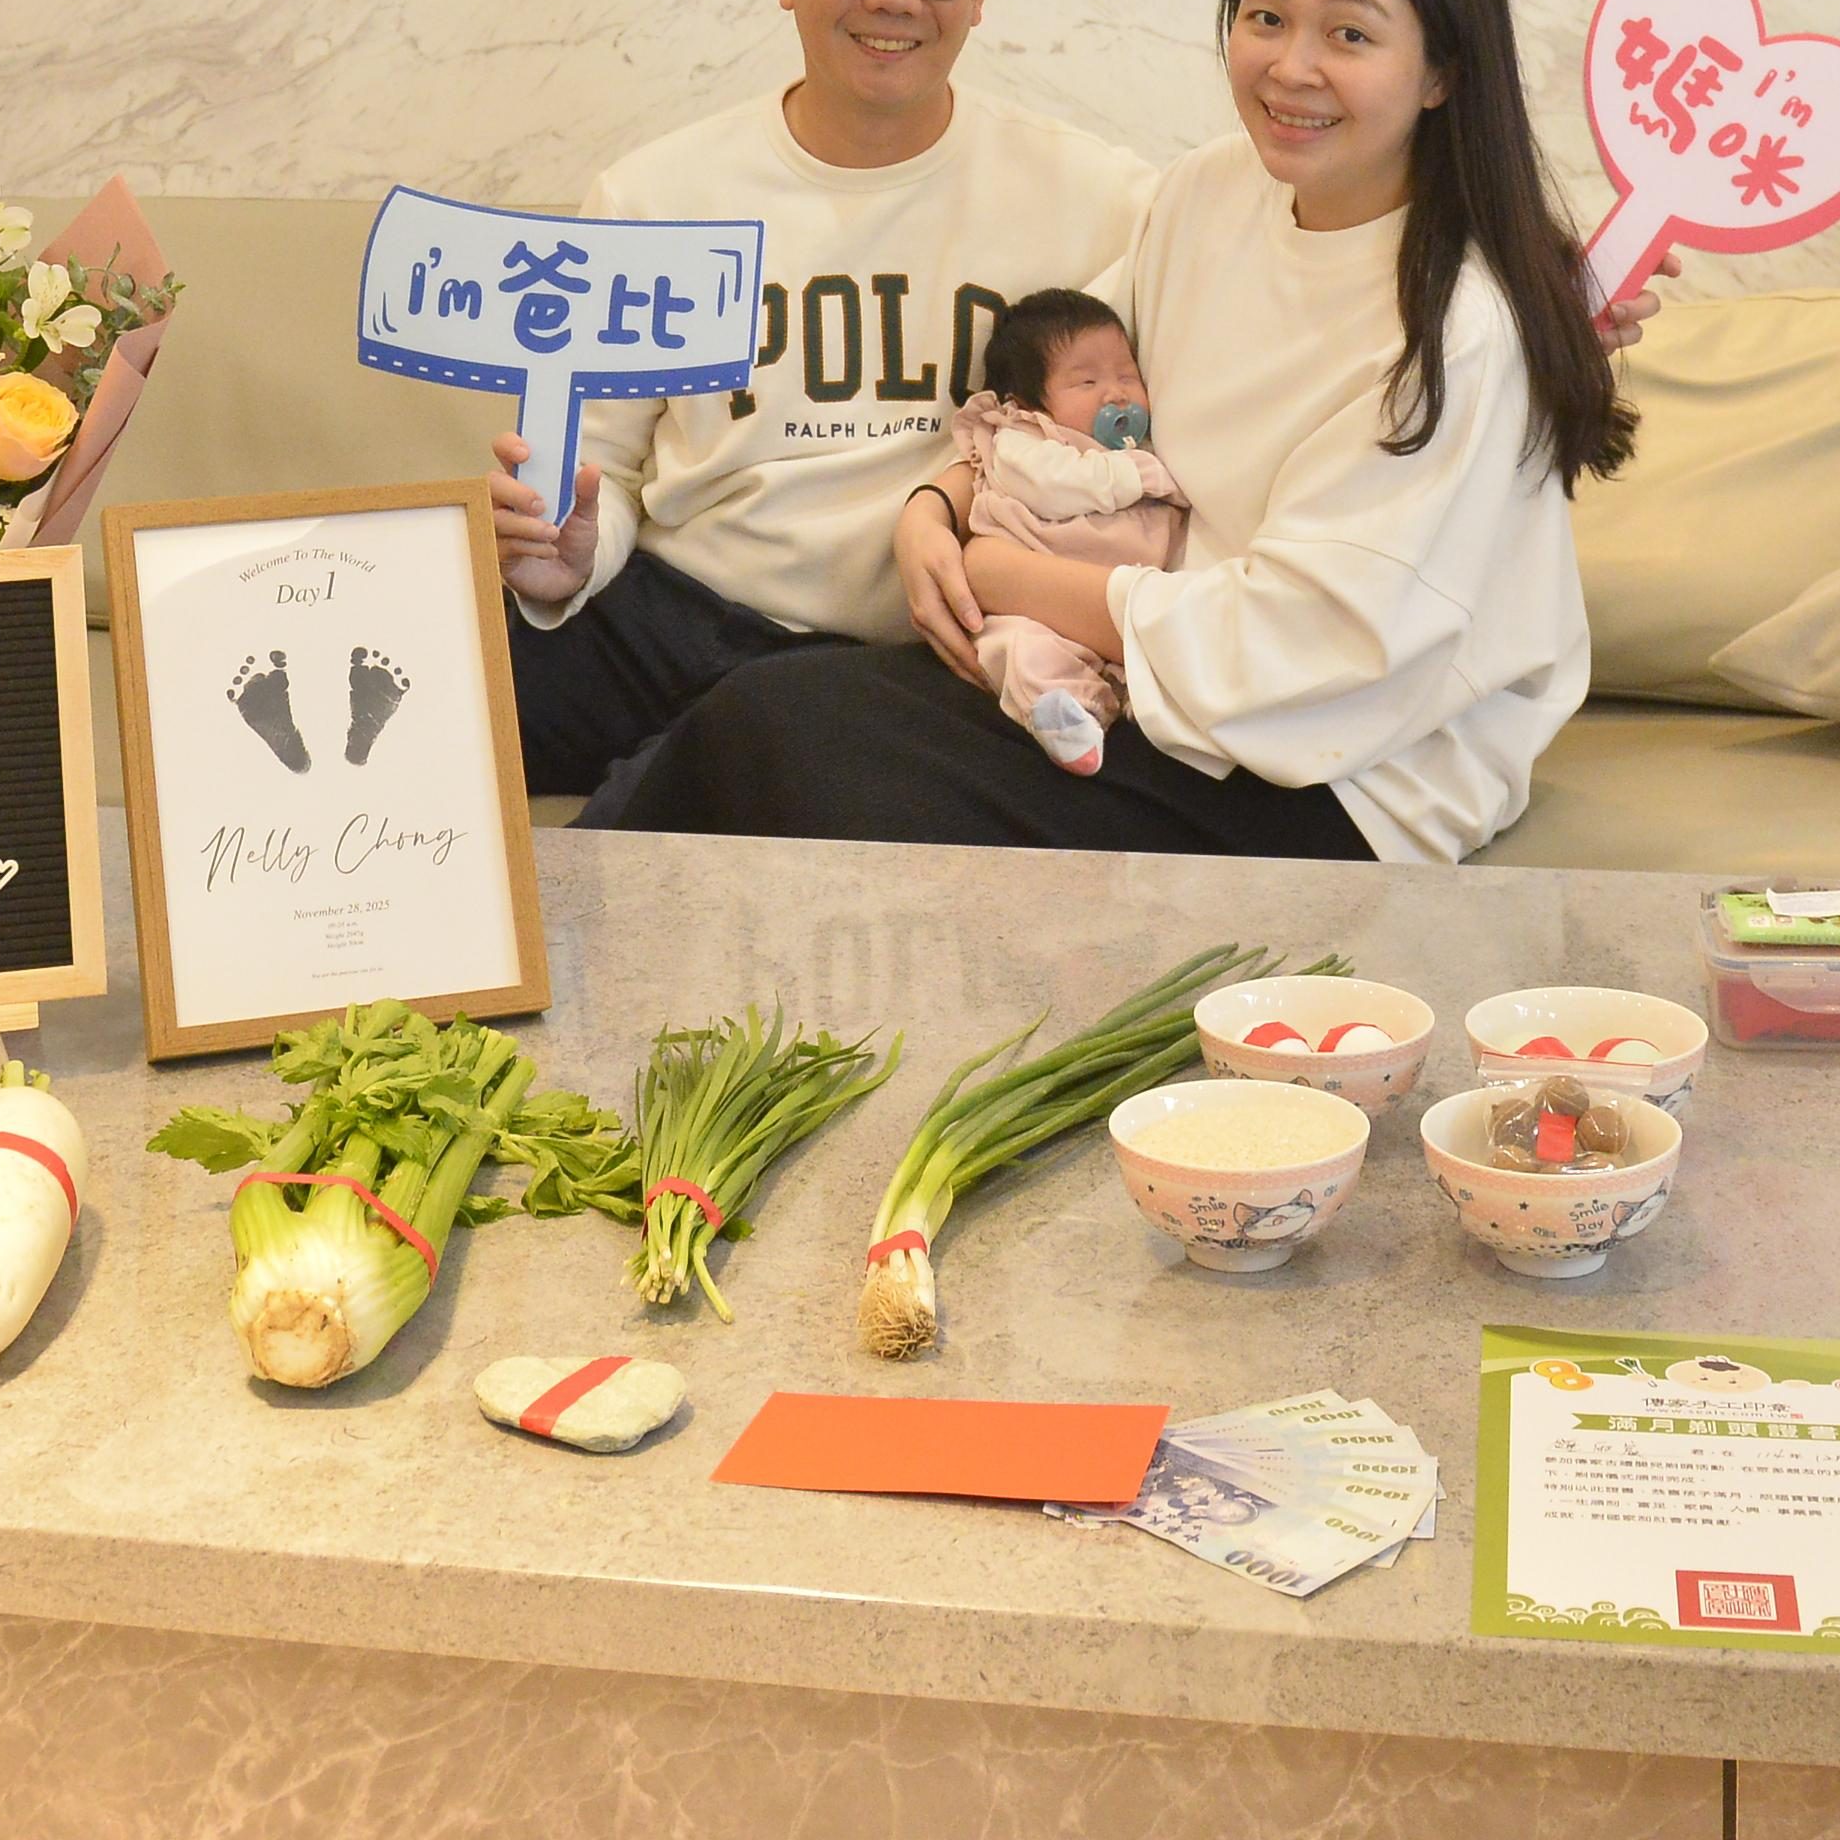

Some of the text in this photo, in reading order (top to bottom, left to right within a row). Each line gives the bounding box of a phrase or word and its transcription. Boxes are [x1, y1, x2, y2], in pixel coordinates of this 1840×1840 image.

[1615, 17, 1806, 207] 媽咪
[498, 240, 695, 355] 爸比
[784, 416, 943, 440] RALPH LAUREN
[238, 548, 377, 584] Welcome To The World
[276, 583, 321, 607] Day
[200, 813, 469, 893] Nelly Chong
[293, 905, 344, 920] November
[365, 899, 390, 913] 2025
[1188, 1196, 1228, 1214] Smile
[1568, 1199, 1609, 1221] Smile
[1196, 1216, 1225, 1228] Day
[1575, 1220, 1604, 1233] Day
[1607, 1415, 1840, 1441] 滿月剃頭證書
[1224, 1549, 1310, 1588] 1000
